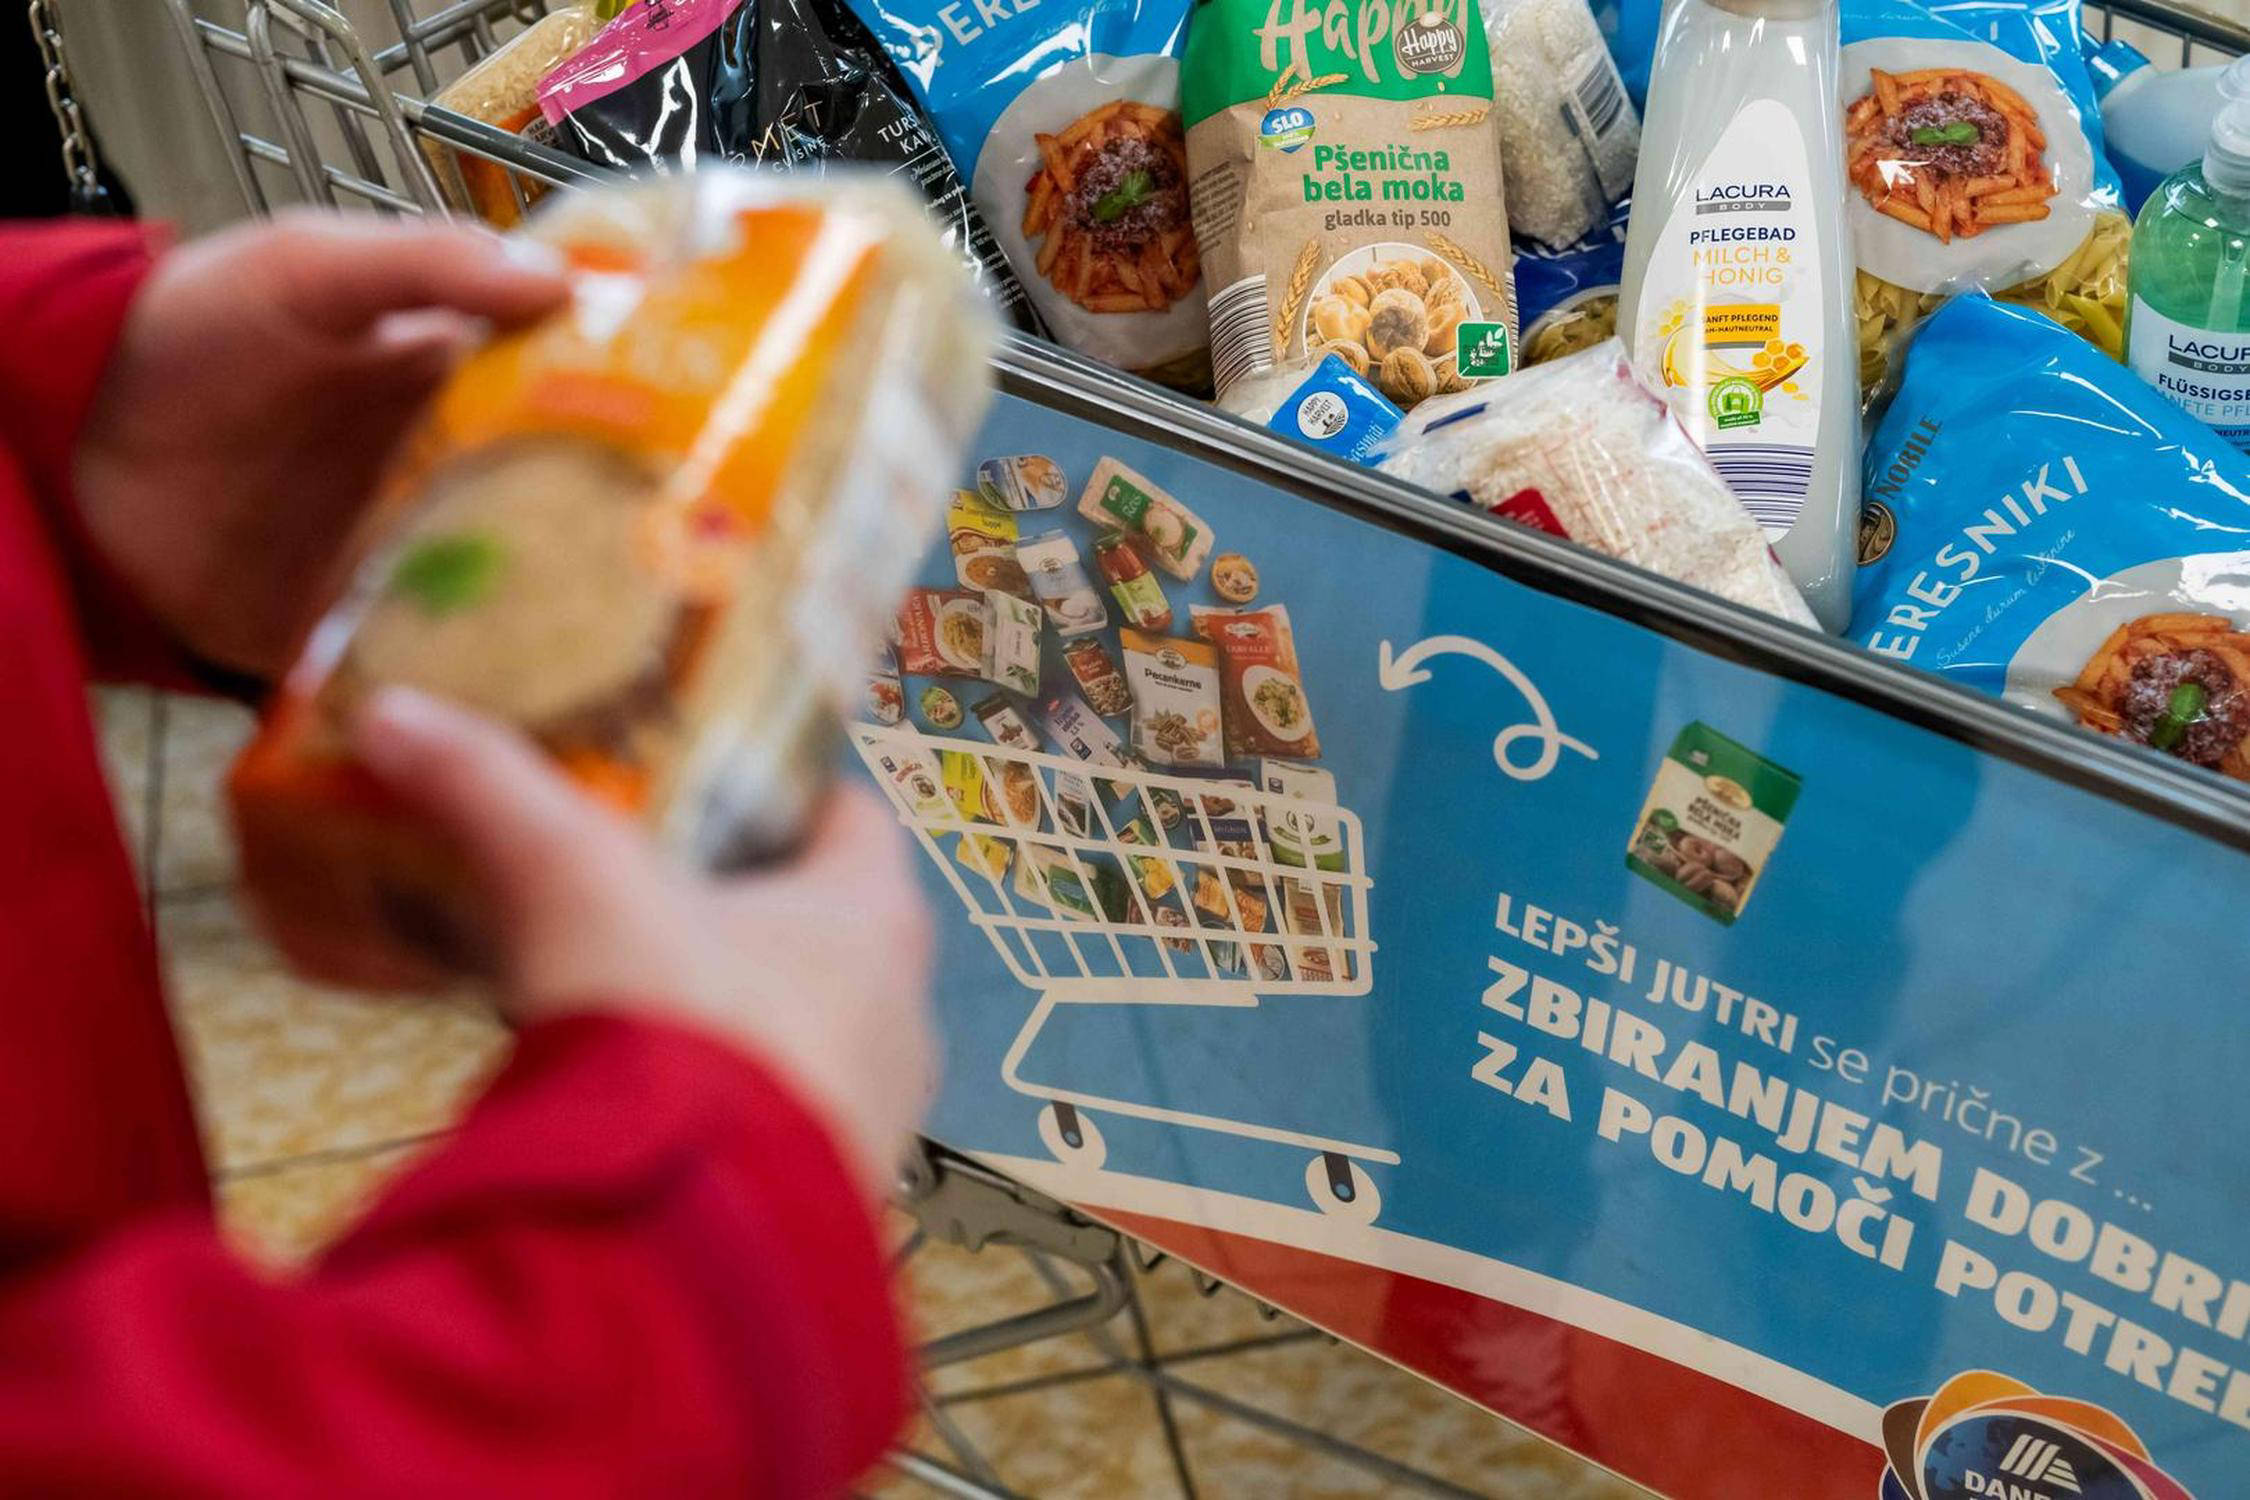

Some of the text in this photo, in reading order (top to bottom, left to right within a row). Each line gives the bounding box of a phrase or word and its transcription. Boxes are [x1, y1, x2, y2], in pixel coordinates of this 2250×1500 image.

[1402, 27, 1457, 55] Happy
[1411, 53, 1455, 68] HARVEST
[1271, 112, 1304, 134] SLO
[1313, 143, 1450, 172] Pšenična
[1303, 173, 1465, 202] bela moka
[1695, 184, 1791, 201] LACURA
[1719, 202, 1766, 211] BODY
[1324, 210, 1451, 231] gladka tip 500
[1690, 227, 1796, 244] PFLEGEBAD
[1693, 246, 1792, 267] MILCH &
[1731, 314, 1779, 323] PFLEGEND
[2193, 361, 2248, 373] BODY
[1874, 414, 1942, 499] NOBILE
[1867, 455, 2089, 661] ERESNIKI
[1495, 892, 1637, 984] LEPŠI
[1645, 959, 1798, 1054] JUTRI
[1808, 1035, 1869, 1084] se
[1882, 1065, 2058, 1165] prične
[2069, 1145, 2104, 1186] z
[1481, 955, 1943, 1201] ZBIRANJEM
[1471, 1030, 1573, 1123] ZA
[1597, 1086, 1915, 1273] POMOČI
